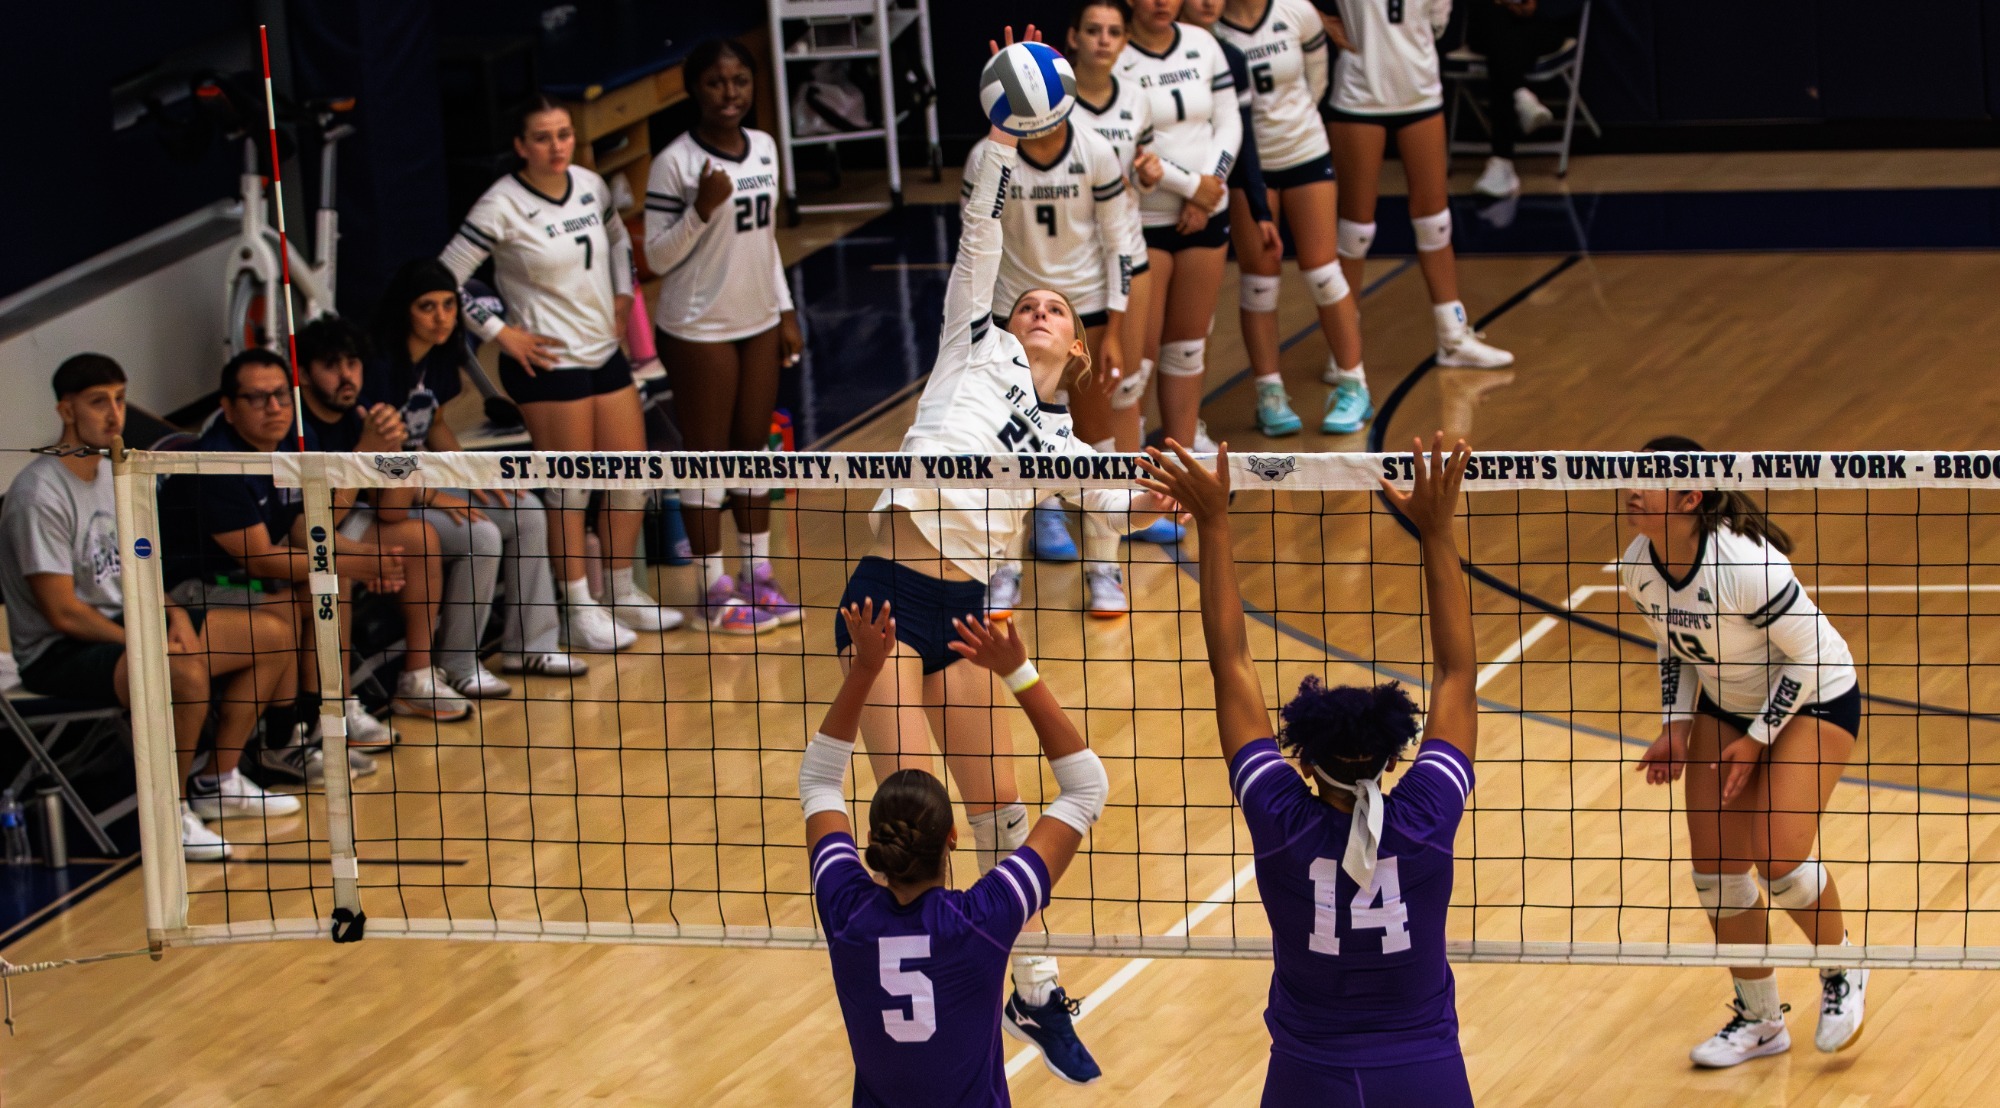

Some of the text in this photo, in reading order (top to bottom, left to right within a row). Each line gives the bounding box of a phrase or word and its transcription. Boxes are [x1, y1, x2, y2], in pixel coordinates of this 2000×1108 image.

[1252, 62, 1275, 94] 6
[1171, 88, 1186, 122] 1
[1029, 184, 1079, 199] JOSEPH'S
[734, 193, 771, 234] 20
[1035, 204, 1057, 236] 9
[574, 234, 593, 270] 7
[1005, 384, 1027, 408] ST.
[501, 456, 538, 479] ST.
[546, 456, 664, 479] JOSEPH'S
[671, 455, 839, 483] UNIVERSITY,
[848, 455, 912, 479] NEW
[921, 455, 994, 479] YORK
[1382, 456, 1415, 480] ST
[1444, 456, 1557, 480] SEPH'S
[1565, 455, 1743, 482] UNIVERSITY,
[1752, 455, 1822, 478] NEW
[1830, 455, 1907, 478] YORK
[1667, 608, 1712, 630] JOSEPH'S
[1667, 630, 1716, 663] 12
[1762, 675, 1803, 728] BEARS
[1308, 856, 1411, 956] 14
[878, 934, 936, 1042] 5
